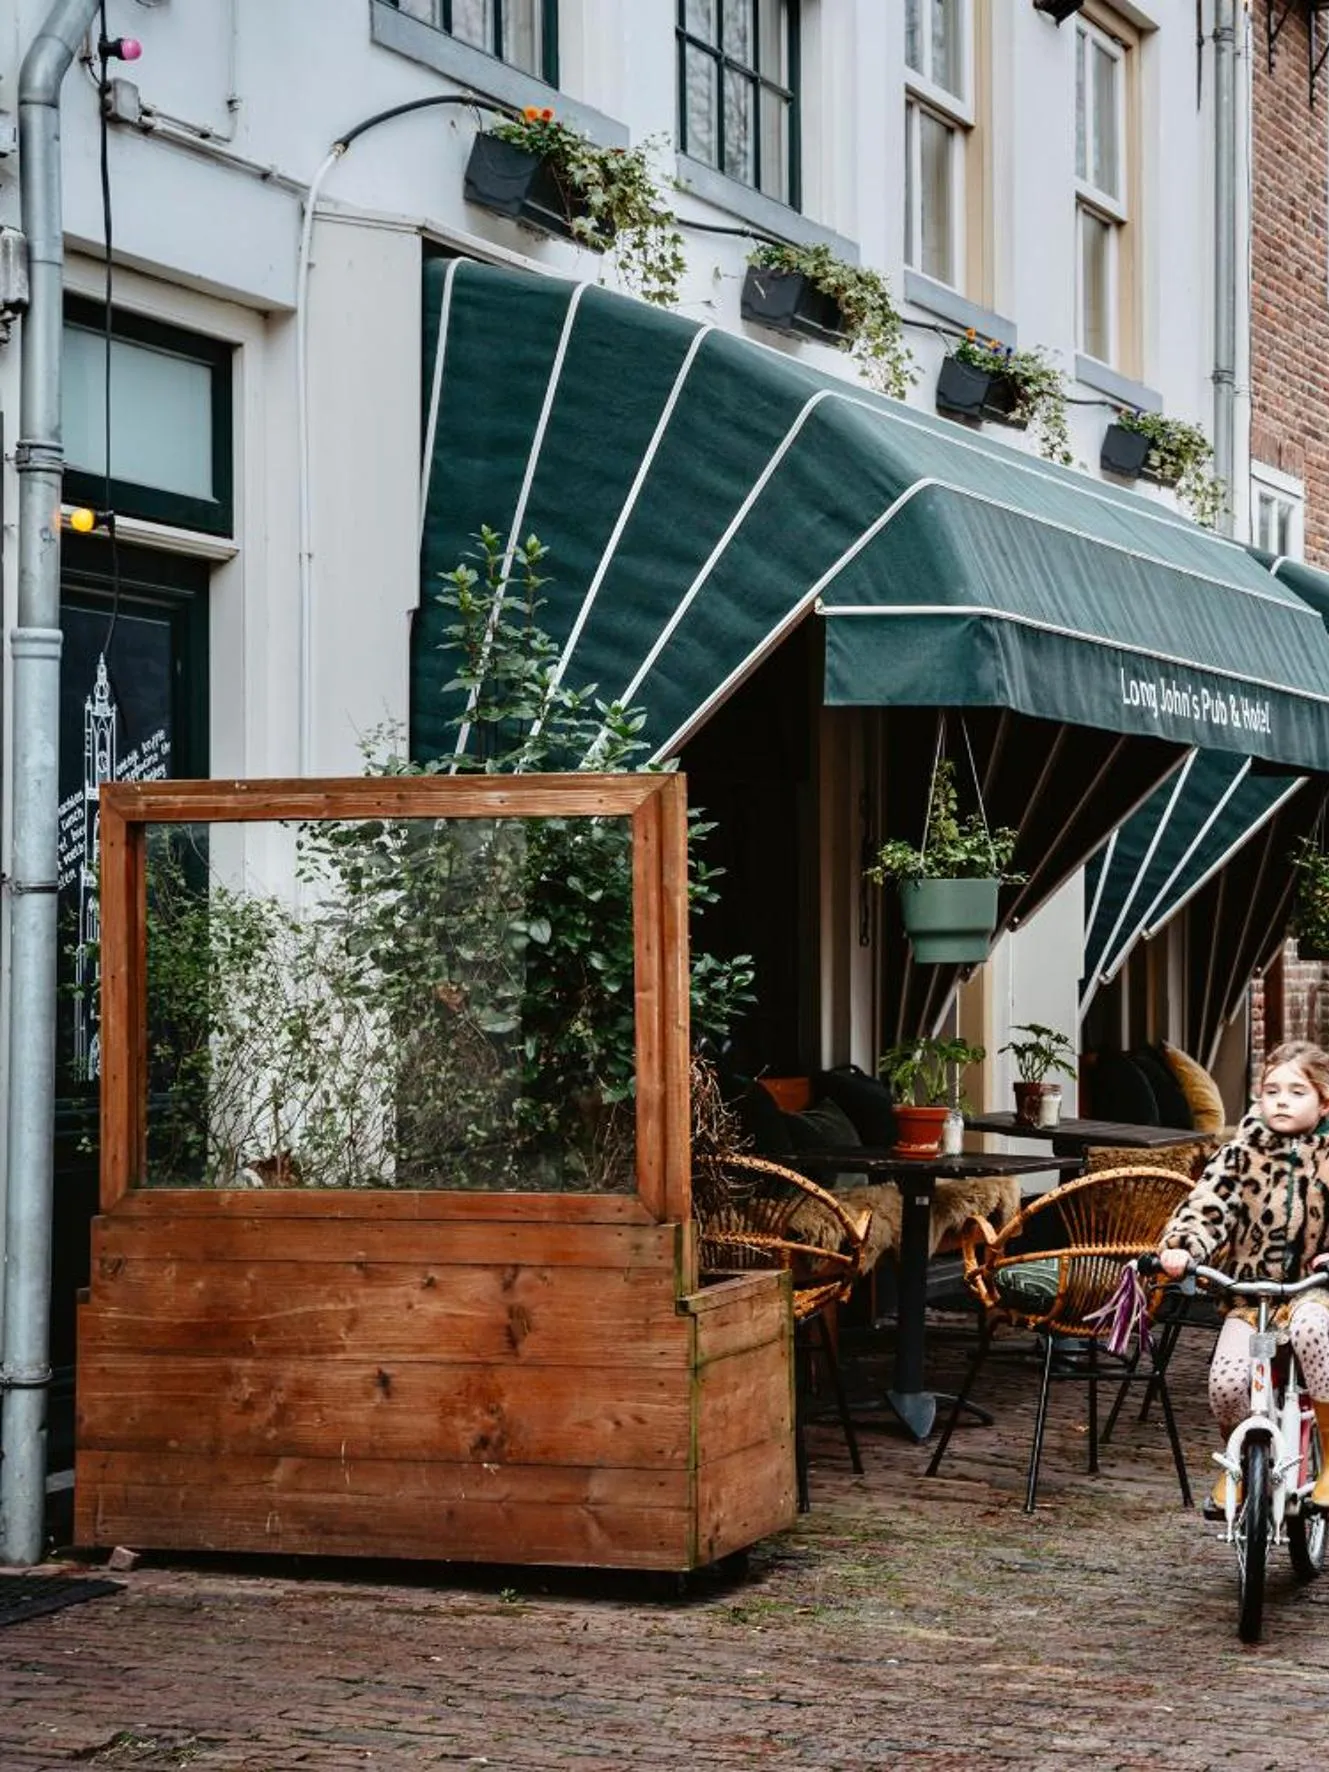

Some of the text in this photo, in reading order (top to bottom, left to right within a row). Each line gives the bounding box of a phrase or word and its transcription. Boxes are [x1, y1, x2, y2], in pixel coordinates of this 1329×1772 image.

[1120, 668, 1271, 734] Long John's Pub & Hotel
